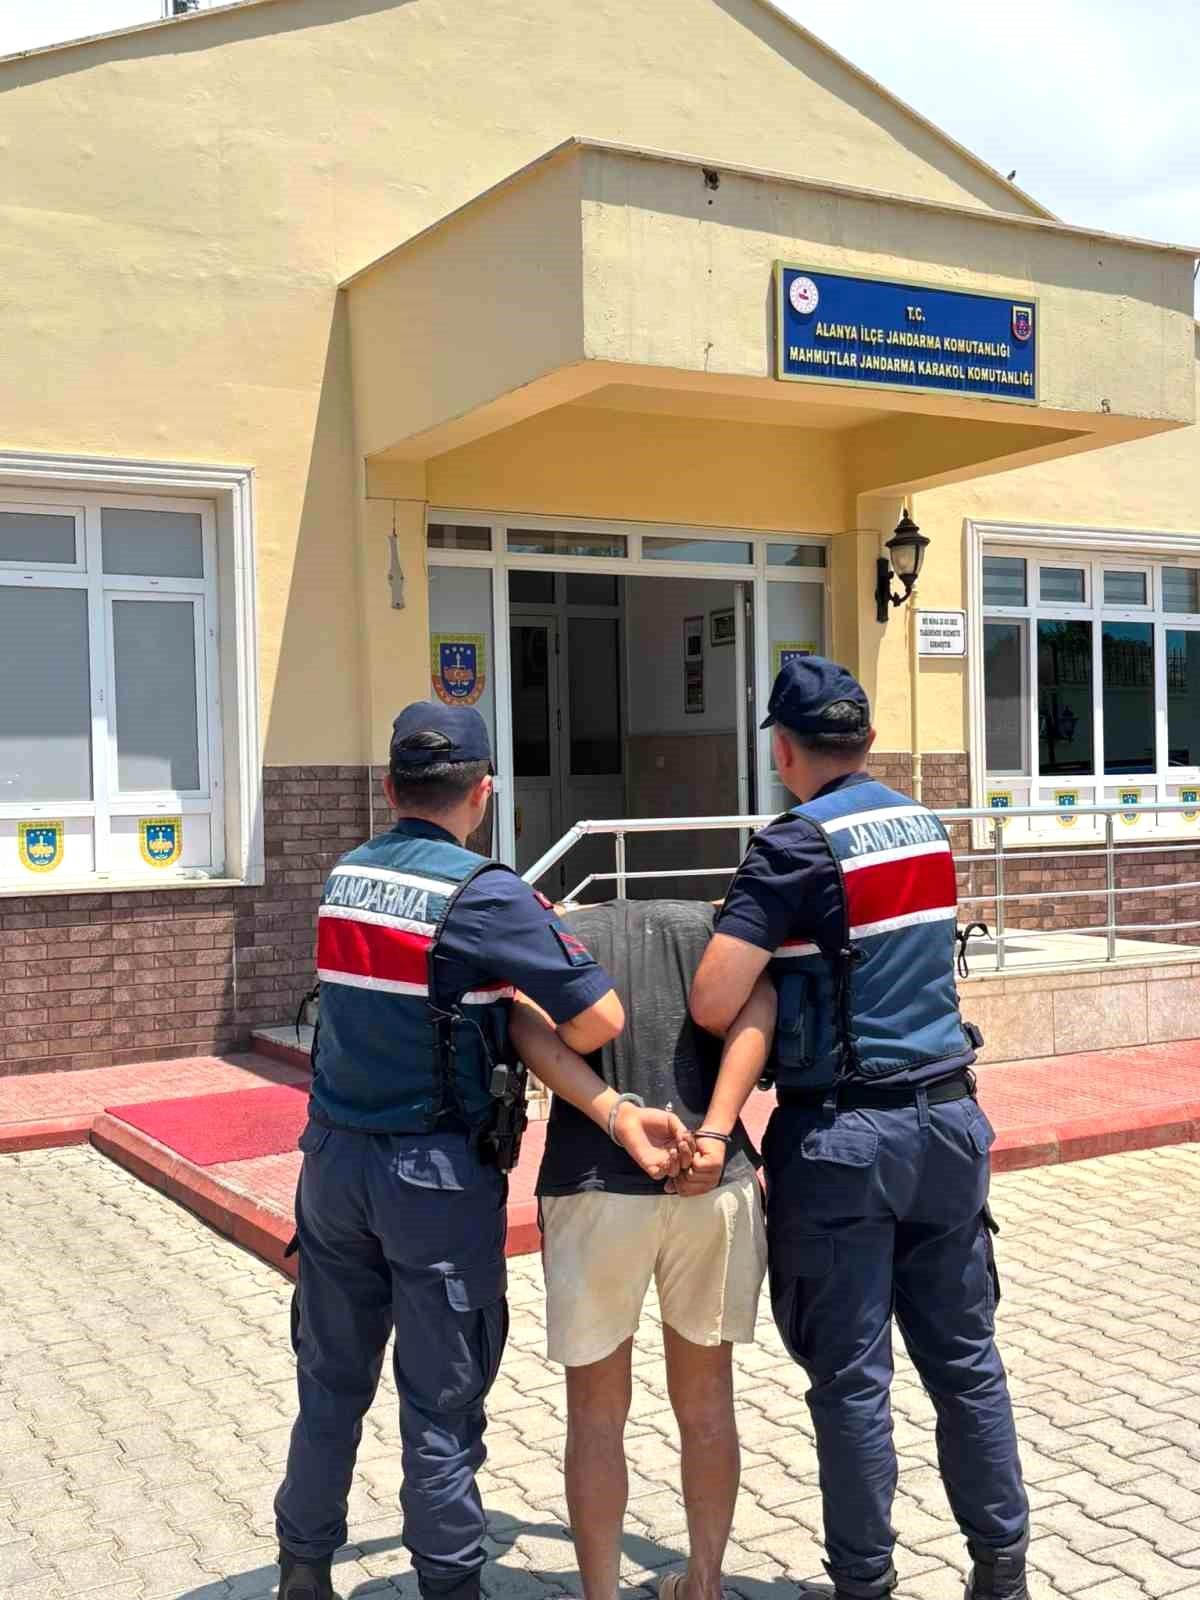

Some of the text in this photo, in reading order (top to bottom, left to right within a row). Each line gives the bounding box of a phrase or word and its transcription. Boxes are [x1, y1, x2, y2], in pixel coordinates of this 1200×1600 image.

[906, 306, 926, 321] T.C.
[816, 322, 1010, 358] ALANYA İLÇE JANDARMA KOMUTANLIĞI
[790, 346, 1033, 387] MAHMUTLAR JANDARMA KARAKOL KOMUTANLIĞI
[849, 814, 942, 854] JANDARMA
[325, 876, 429, 921] JANDARMA
